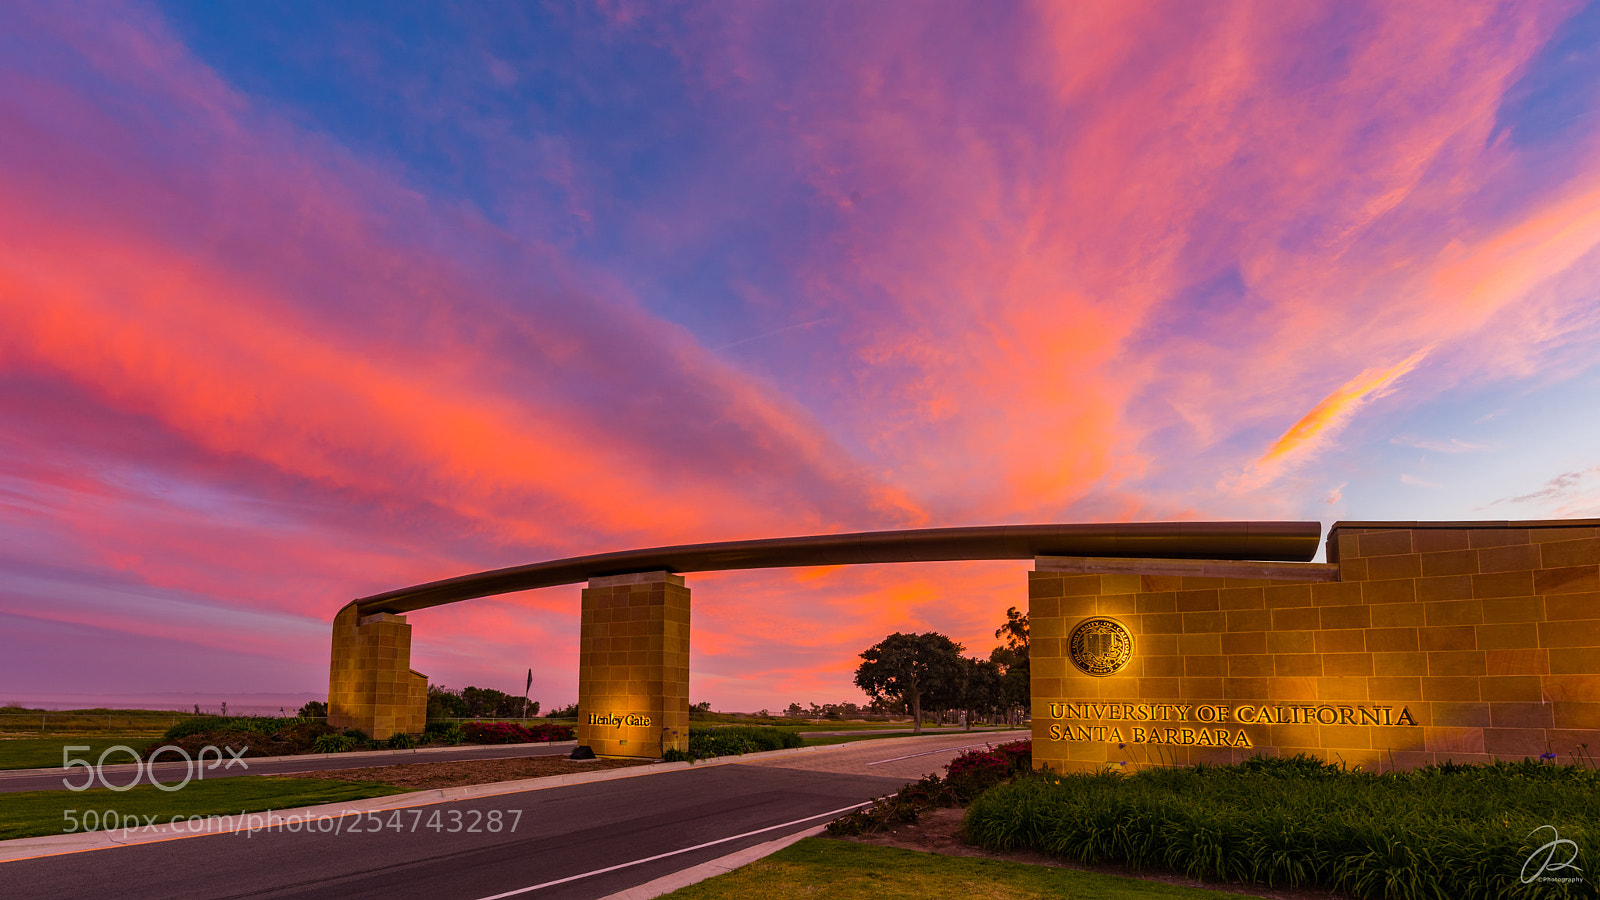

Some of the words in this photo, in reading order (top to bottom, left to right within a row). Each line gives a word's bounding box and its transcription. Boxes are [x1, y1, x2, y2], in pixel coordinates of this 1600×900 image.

[588, 712, 624, 729] Henley
[625, 713, 652, 727] Gate
[1050, 703, 1190, 722] UNIVERSITY
[1197, 705, 1230, 722] OF
[1236, 705, 1418, 726] CALIFORNIA
[1050, 725, 1124, 743] SANTA
[1132, 727, 1252, 747] BARBARA
